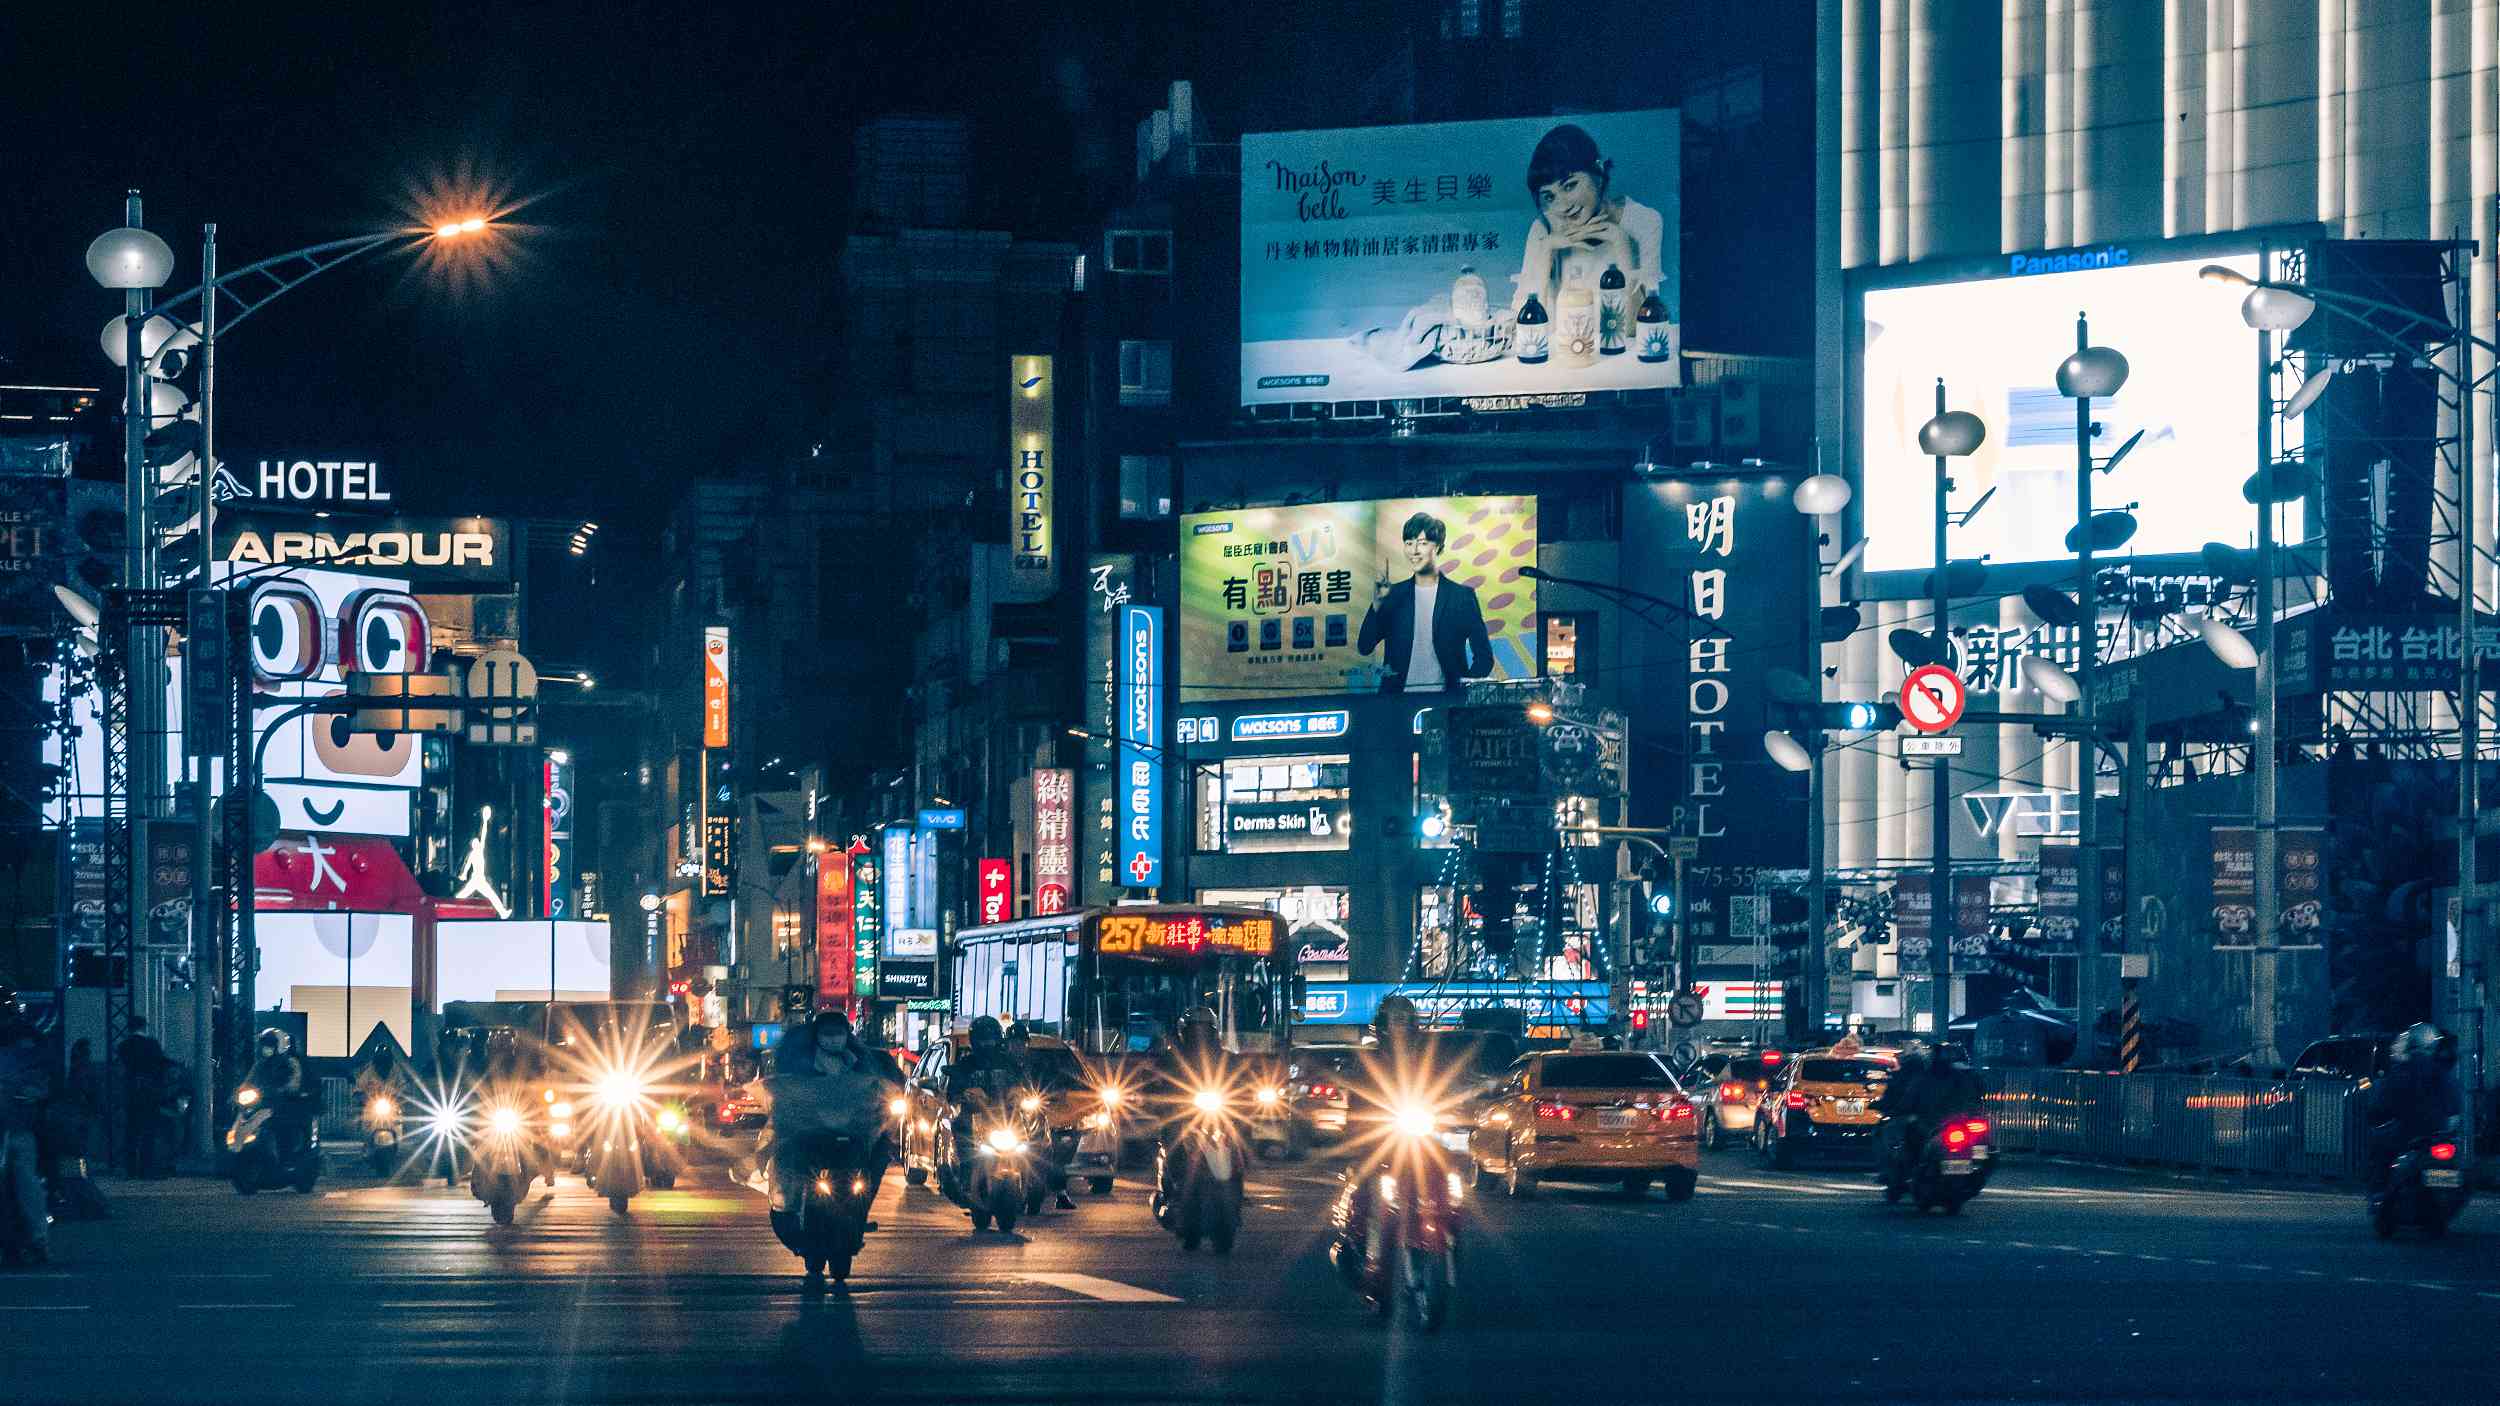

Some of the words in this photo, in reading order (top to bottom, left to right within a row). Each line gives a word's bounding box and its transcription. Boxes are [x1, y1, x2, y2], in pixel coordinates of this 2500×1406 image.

[1298, 191, 1350, 223] belle
[1372, 173, 1492, 206] 美生貝樂
[2010, 245, 2129, 275] Panasonic
[259, 461, 391, 500] HOTEL
[1019, 450, 1044, 553] HOTEL
[228, 531, 494, 566] ARMOUR
[1686, 495, 1735, 620] 明日
[1222, 567, 1352, 610] 有點厲害
[2331, 625, 2393, 661] 台北
[2400, 625, 2462, 661] 台北
[1134, 628, 1147, 732] watsons
[1239, 718, 1302, 735] watsons
[1690, 637, 1731, 837] HOTEL
[1233, 815, 1276, 832] Derma
[1278, 813, 1307, 830] Skin
[297, 834, 348, 893] 大
[1100, 916, 1146, 953] 257
